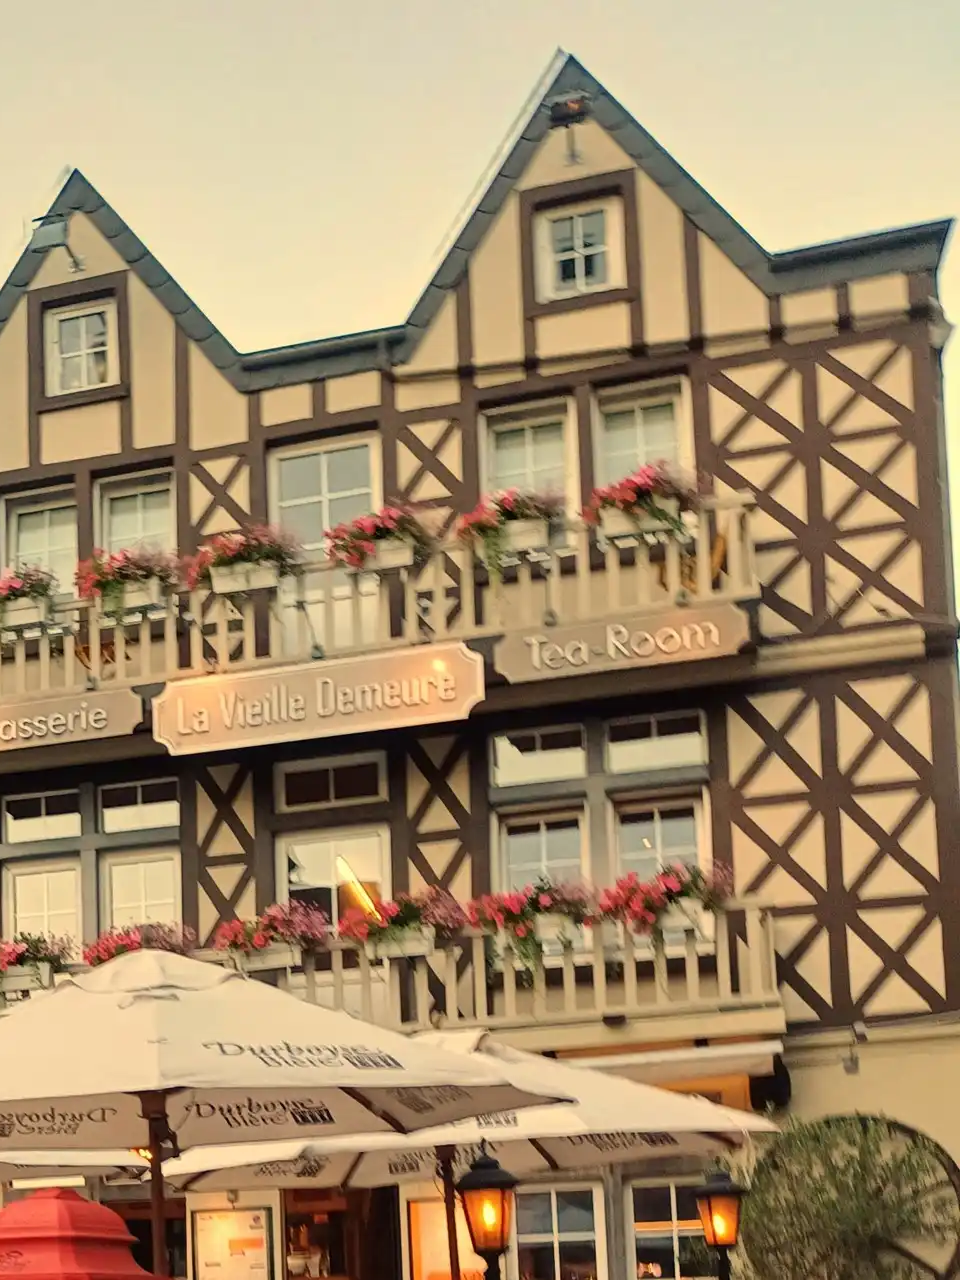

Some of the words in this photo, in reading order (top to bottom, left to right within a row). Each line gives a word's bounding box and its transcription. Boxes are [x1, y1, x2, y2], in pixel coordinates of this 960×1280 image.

[524, 621, 720, 670] Tea-Room
[176, 697, 210, 735] La
[219, 682, 306, 729] Vieille
[316, 672, 457, 717] Demeure
